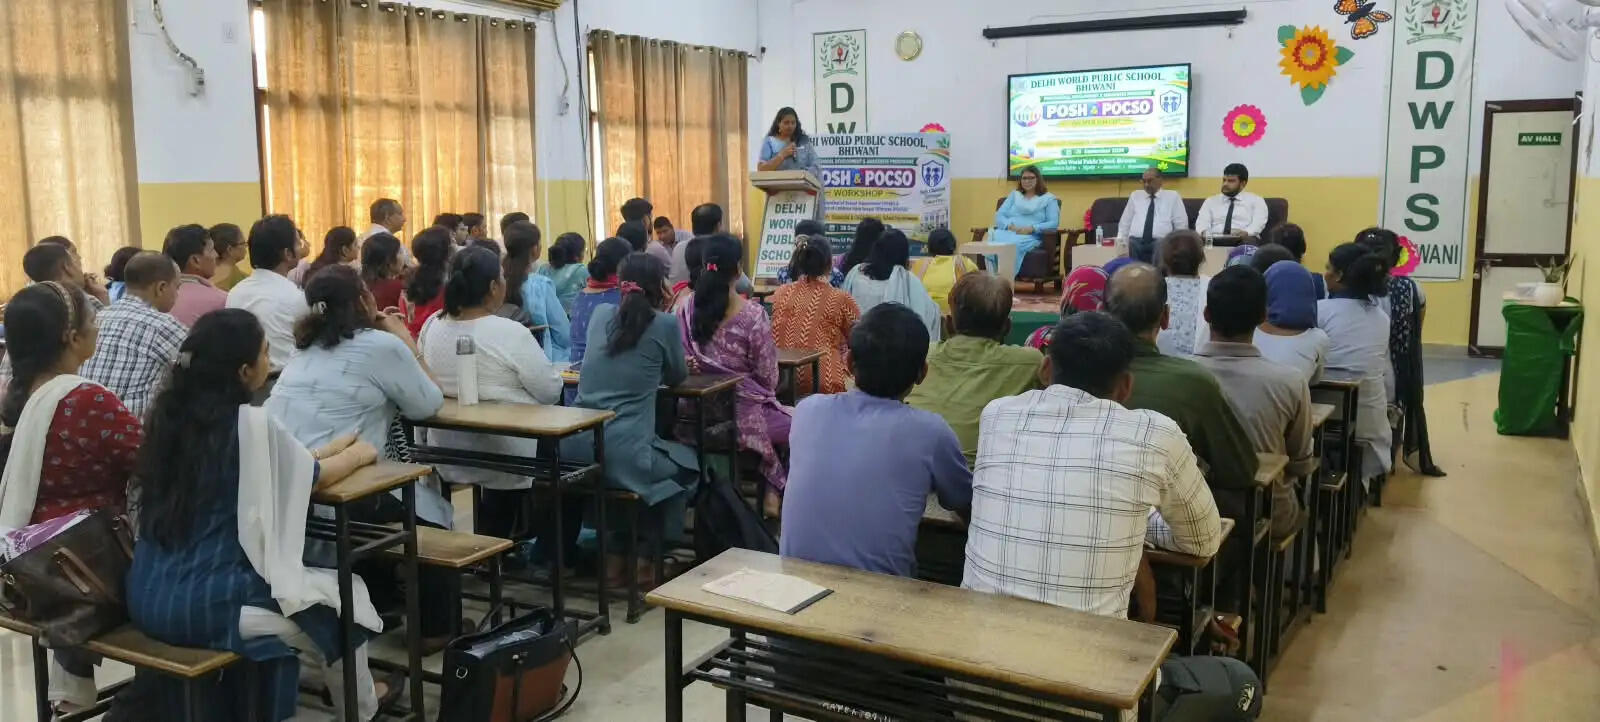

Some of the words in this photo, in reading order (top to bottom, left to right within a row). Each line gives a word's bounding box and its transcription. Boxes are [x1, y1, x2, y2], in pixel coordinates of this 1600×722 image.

[1031, 78, 1056, 89] DELHI
[1058, 75, 1089, 85] WORLD
[1091, 73, 1123, 83] PUBLIC
[1076, 82, 1116, 92] BHIWANI
[1046, 103, 1088, 119] POSH
[1101, 100, 1151, 116] POCSO
[821, 136, 852, 146] WORLD
[854, 135, 886, 146] PUBLIC
[888, 136, 928, 149] SCHOOL,
[1521, 135, 1533, 143] AV
[1535, 135, 1559, 143] HALL
[838, 146, 879, 156] BHIWANI
[822, 170, 851, 186] OSH
[864, 170, 913, 186] POCSO
[834, 189, 884, 198] WORKSHOP
[774, 203, 806, 214] DELHI
[766, 234, 795, 245] PUBL
[760, 250, 791, 261] SCHO
[1418, 244, 1458, 265] WANI
